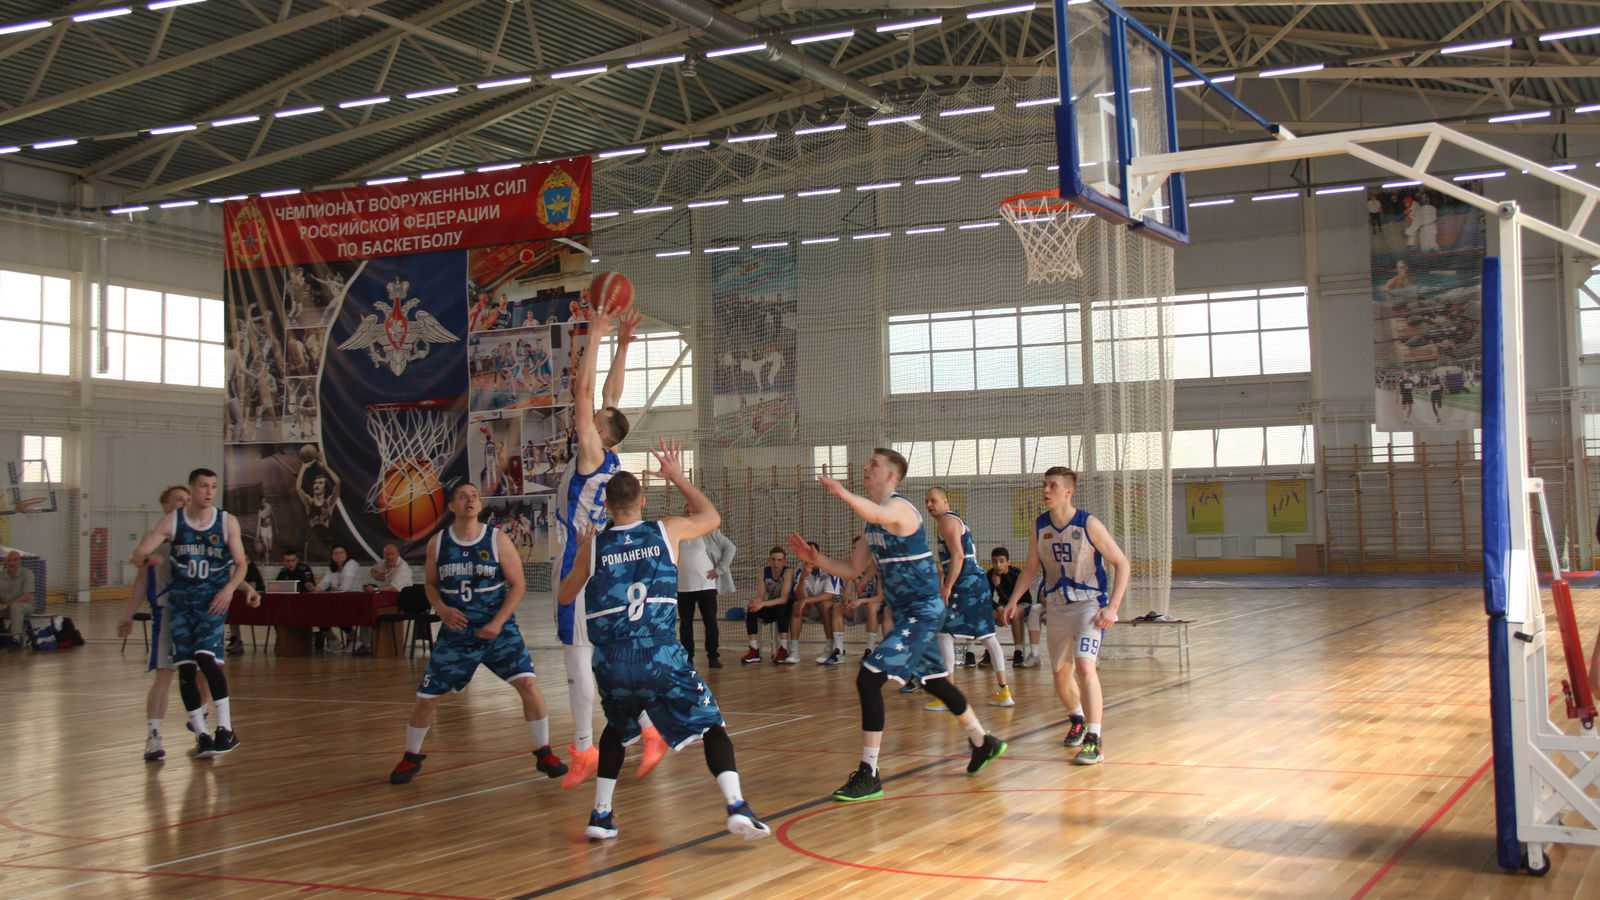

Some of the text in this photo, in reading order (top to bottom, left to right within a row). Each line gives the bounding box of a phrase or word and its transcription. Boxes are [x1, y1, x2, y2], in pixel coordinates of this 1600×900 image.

[275, 178, 527, 221] ЧЕМПИОНАТ ВООРУЖЕННЫХ СИЛ
[300, 203, 500, 240] РОССИЙСКОЙ ФЕДЕРАЦИИ
[337, 230, 463, 258] ПО БАСКЕТБОЛУ
[601, 545, 661, 567] РОМАНЕНКО
[1052, 543, 1073, 562] 69
[187, 559, 210, 579] 00
[460, 580, 472, 602] 5
[626, 581, 648, 622] 8
[1080, 637, 1100, 655] 69
[423, 674, 431, 687] 5
